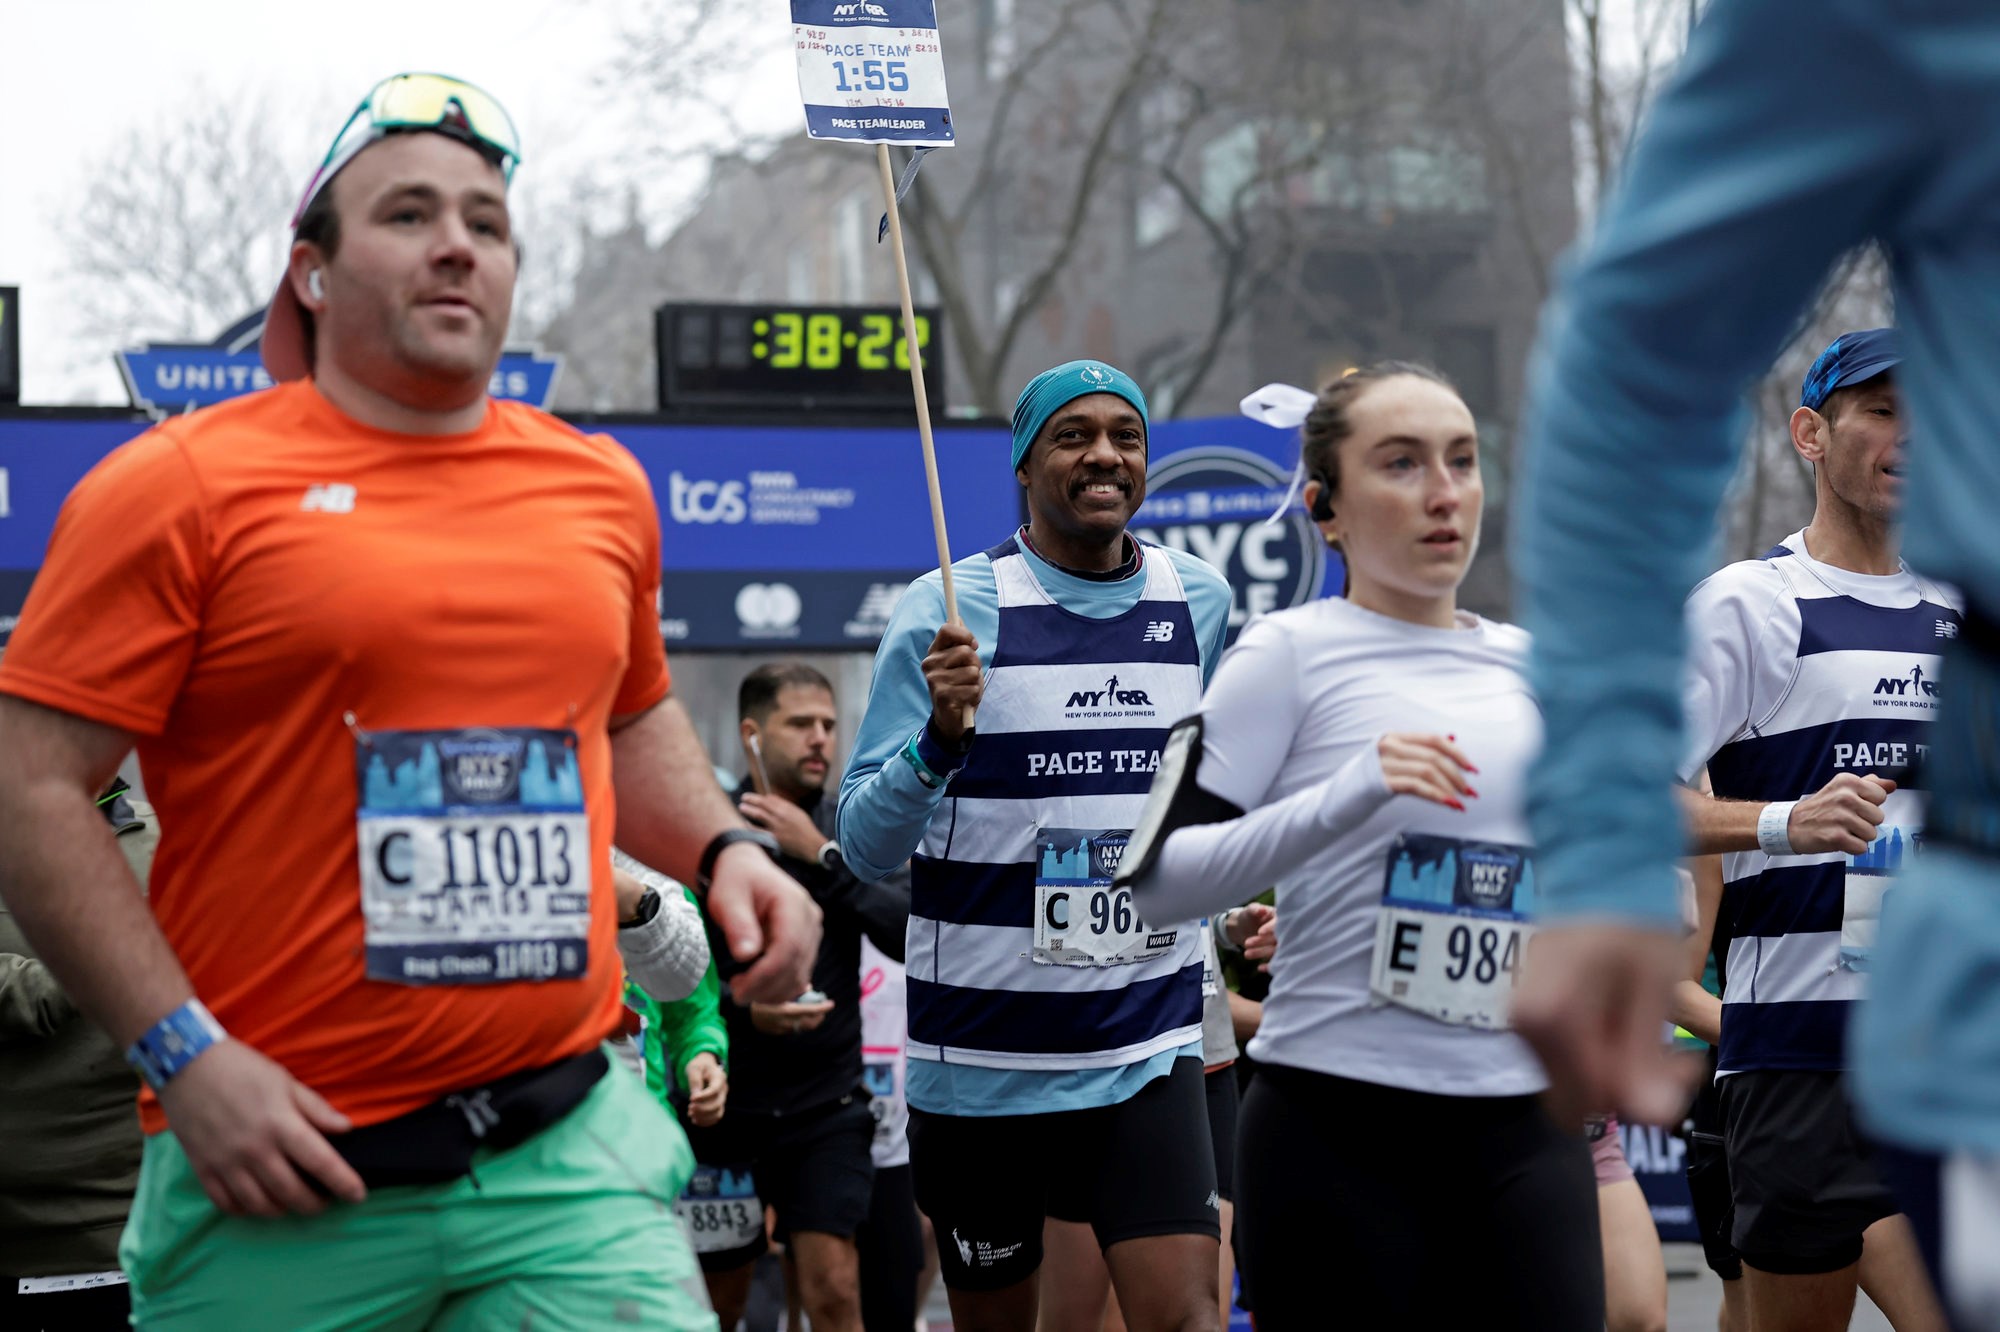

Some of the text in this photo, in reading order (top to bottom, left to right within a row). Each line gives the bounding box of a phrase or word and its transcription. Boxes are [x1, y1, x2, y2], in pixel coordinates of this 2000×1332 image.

[826, 43, 909, 57] PACE TEAM
[832, 60, 909, 91] 1:55
[831, 118, 926, 129] PACE TEAM LEADER
[156, 364, 276, 391] UNITE
[669, 470, 747, 524] tcs
[1143, 621, 1175, 642] NB
[1873, 678, 1941, 697] NYR
[1910, 701, 1928, 709] ROAD
[1028, 750, 1161, 777] PACE TEA
[1833, 742, 1908, 768] PACE
[377, 824, 571, 888] C 11013
[1102, 846, 1125, 858] NY
[1103, 859, 1120, 868] HA
[1472, 862, 1509, 882] NYC
[1046, 892, 1070, 930] C
[1090, 891, 1159, 935] 96
[1149, 934, 1175, 946] WAVE 2
[1389, 921, 1523, 989] E 984
[691, 1202, 749, 1233] 8843
[979, 1251, 1013, 1260] MARATHON
